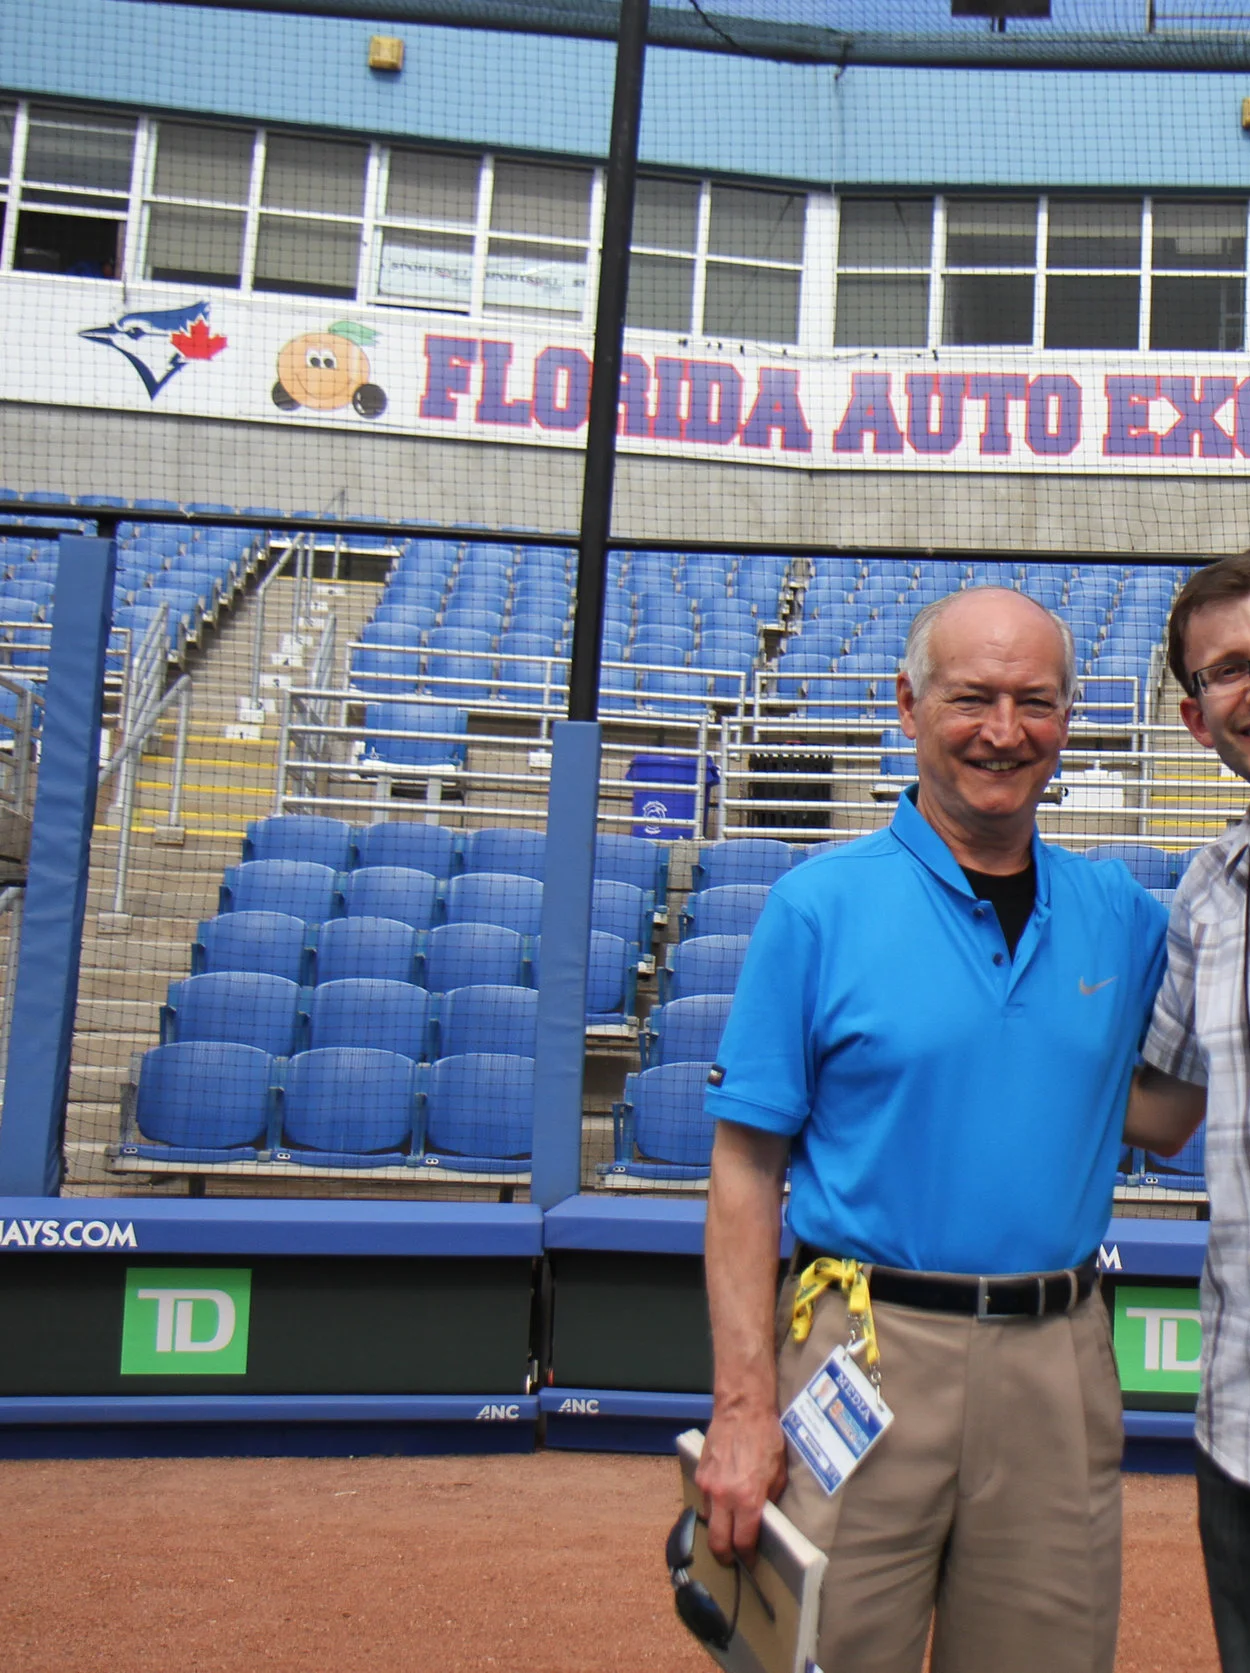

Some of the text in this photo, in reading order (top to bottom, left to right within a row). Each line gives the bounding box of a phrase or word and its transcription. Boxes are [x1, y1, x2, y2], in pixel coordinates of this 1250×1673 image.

[419, 334, 812, 452] FLORIDA
[832, 371, 1082, 456] AUTO
[137, 1288, 236, 1352] TD
[1126, 1307, 1202, 1371] TD
[475, 1404, 520, 1419] ANC
[557, 1398, 600, 1413] ANC
[836, 1372, 871, 1423] MEDIA
